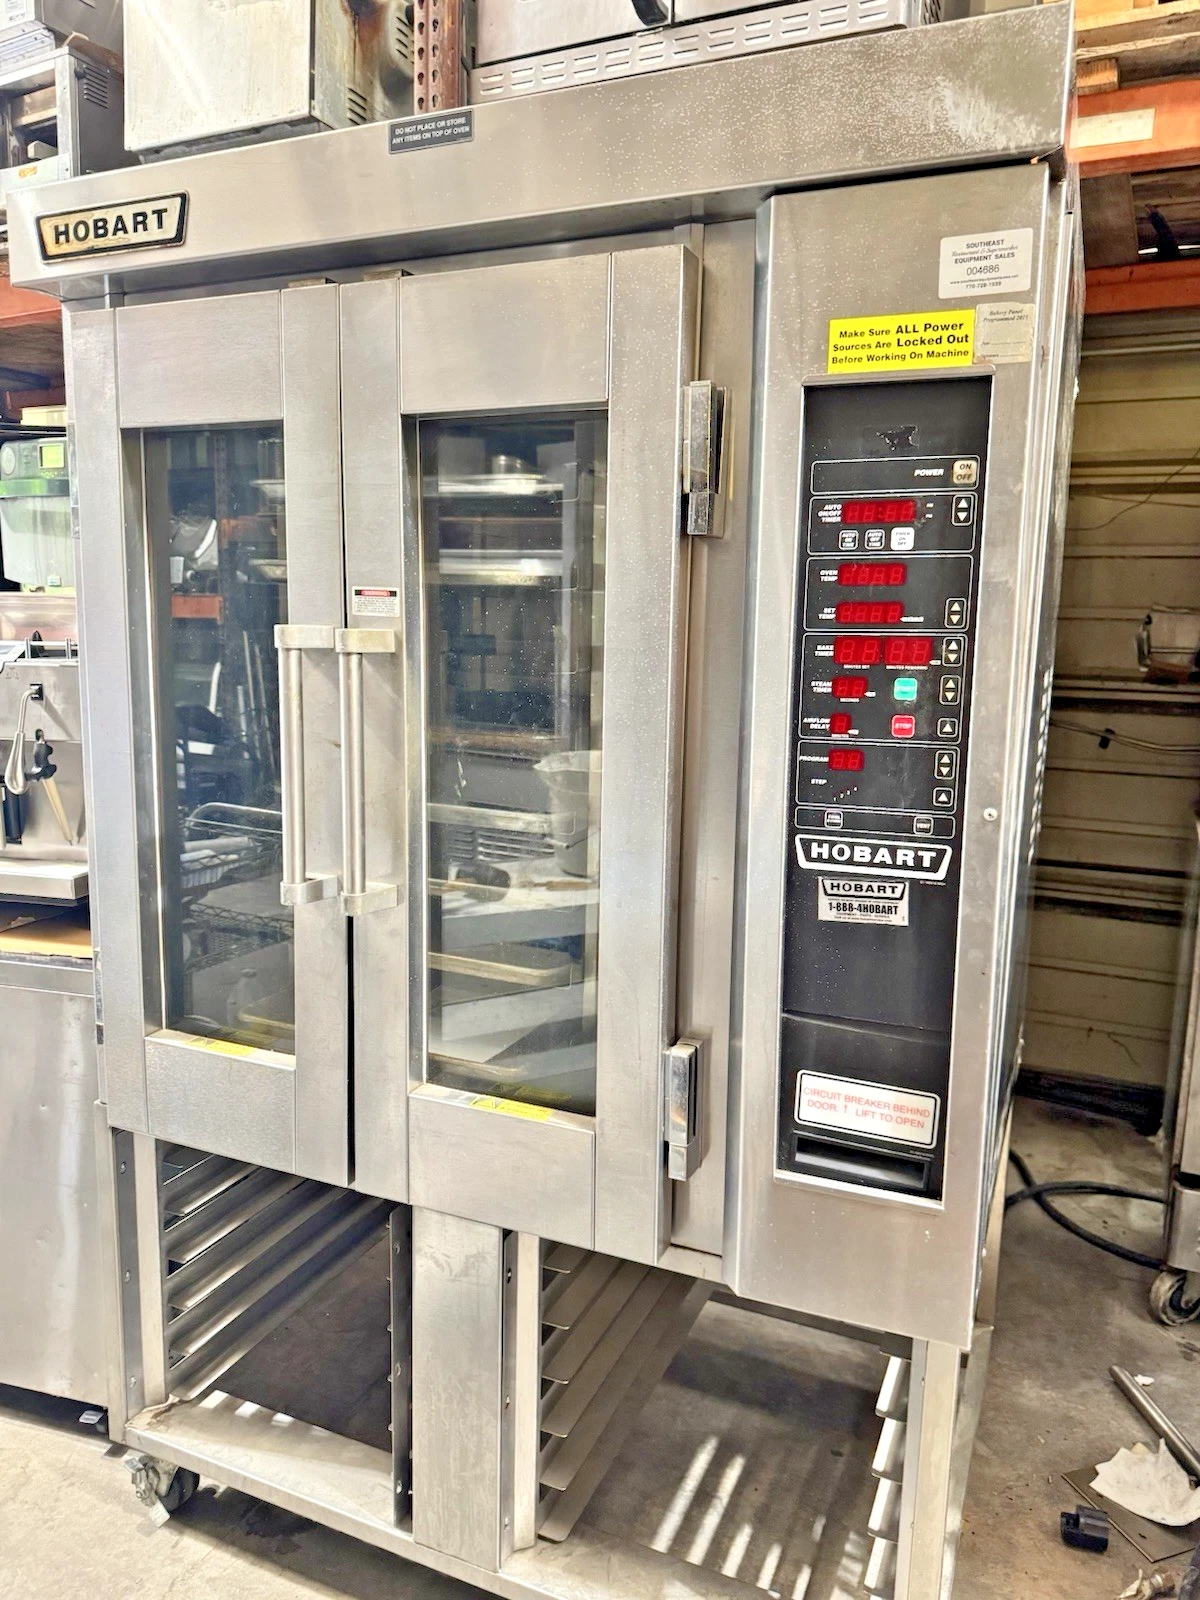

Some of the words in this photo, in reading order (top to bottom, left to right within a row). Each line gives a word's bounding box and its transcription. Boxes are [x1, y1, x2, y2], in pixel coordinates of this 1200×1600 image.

[416, 122, 436, 131] PLACE
[436, 120, 446, 128] OR
[446, 117, 466, 126] STORE
[404, 134, 421, 142] ITEMS
[432, 130, 444, 138] TOP
[453, 126, 470, 134] OVEN
[54, 208, 168, 244] HOBART
[966, 239, 1005, 249] SOUTHEAST
[954, 254, 992, 264] EQUIPMENT
[994, 252, 1016, 260] SALES
[966, 264, 1000, 276] 004686
[839, 330, 865, 338] Make
[868, 328, 890, 336] Sure
[896, 324, 920, 334] ALL
[924, 322, 964, 332] Power
[833, 343, 872, 352] Sources
[897, 335, 942, 347] Locked
[947, 334, 969, 344] Out
[832, 356, 863, 364] Before
[866, 352, 906, 362] Working
[910, 351, 923, 359] On
[926, 348, 969, 358] Machine
[914, 468, 944, 476] POWER
[810, 842, 937, 868] HOBART
[830, 882, 898, 894] HOBART
[828, 901, 899, 916] 1-888-4HOBART
[803, 1086, 842, 1100] CIRCUIT
[844, 1094, 891, 1110] BREAKER
[893, 1104, 930, 1118] BEHIND
[856, 1108, 877, 1120] LIFT
[878, 1113, 893, 1122] TO
[895, 1116, 925, 1128] OPEN
